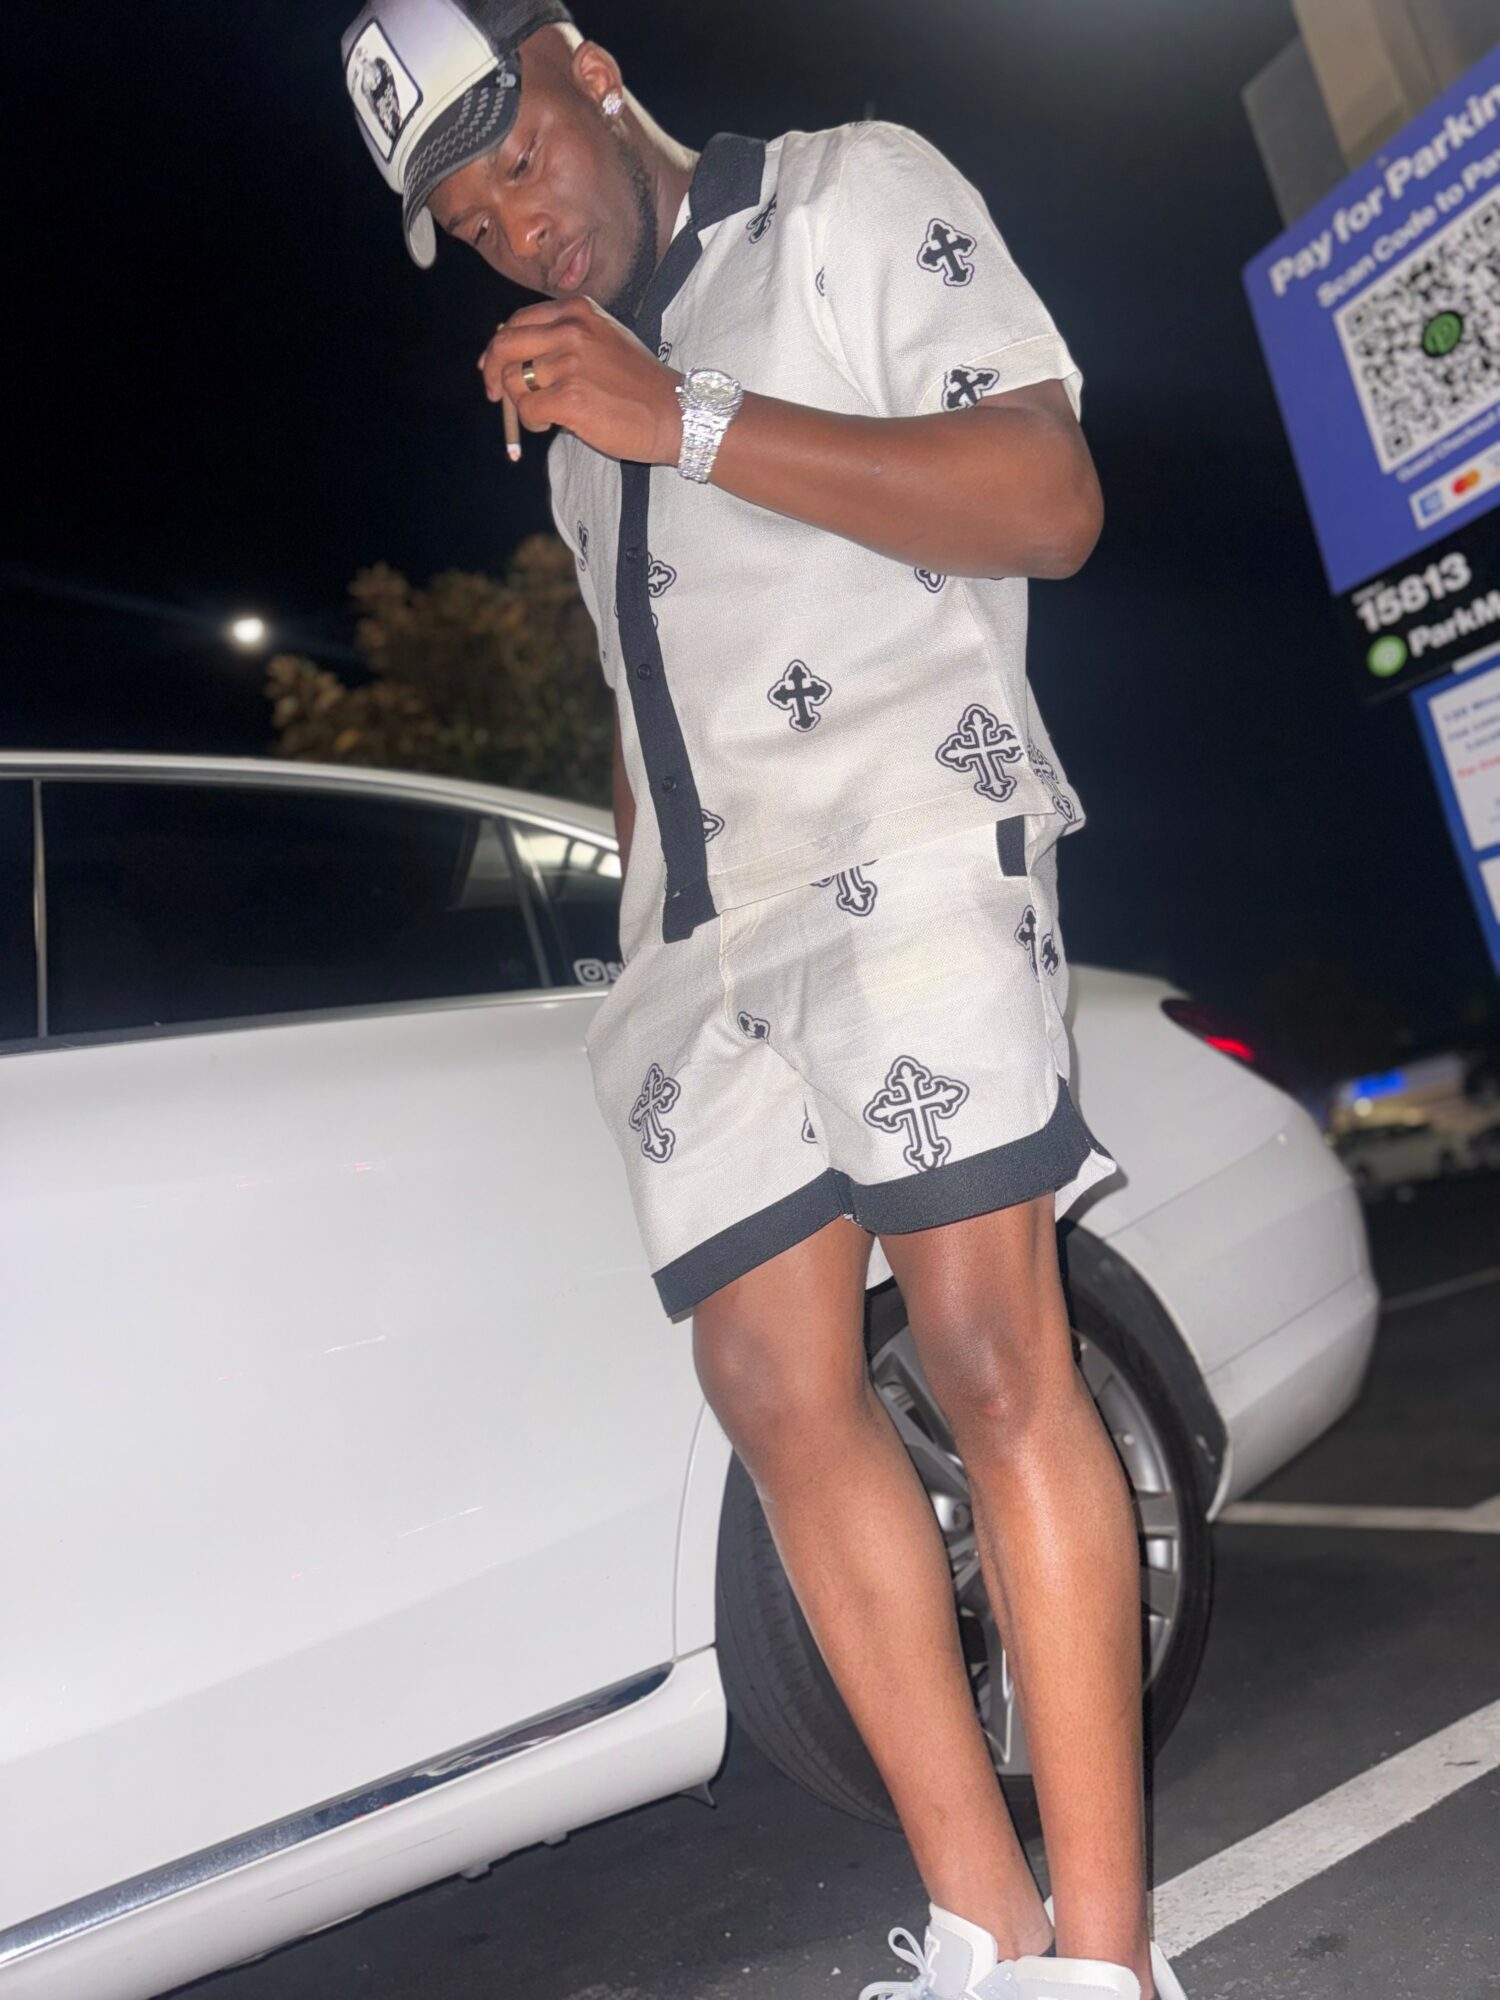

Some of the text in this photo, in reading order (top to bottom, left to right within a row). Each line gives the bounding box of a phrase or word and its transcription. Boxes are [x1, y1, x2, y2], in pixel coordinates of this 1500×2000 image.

[1269, 230, 1332, 296] Pay
[1332, 186, 1384, 243] for
[1316, 254, 1376, 308] Scan
[1372, 205, 1437, 262] Code
[1435, 183, 1465, 213] to
[1356, 552, 1472, 634] 15813
[1407, 589, 1500, 658] ParkM
